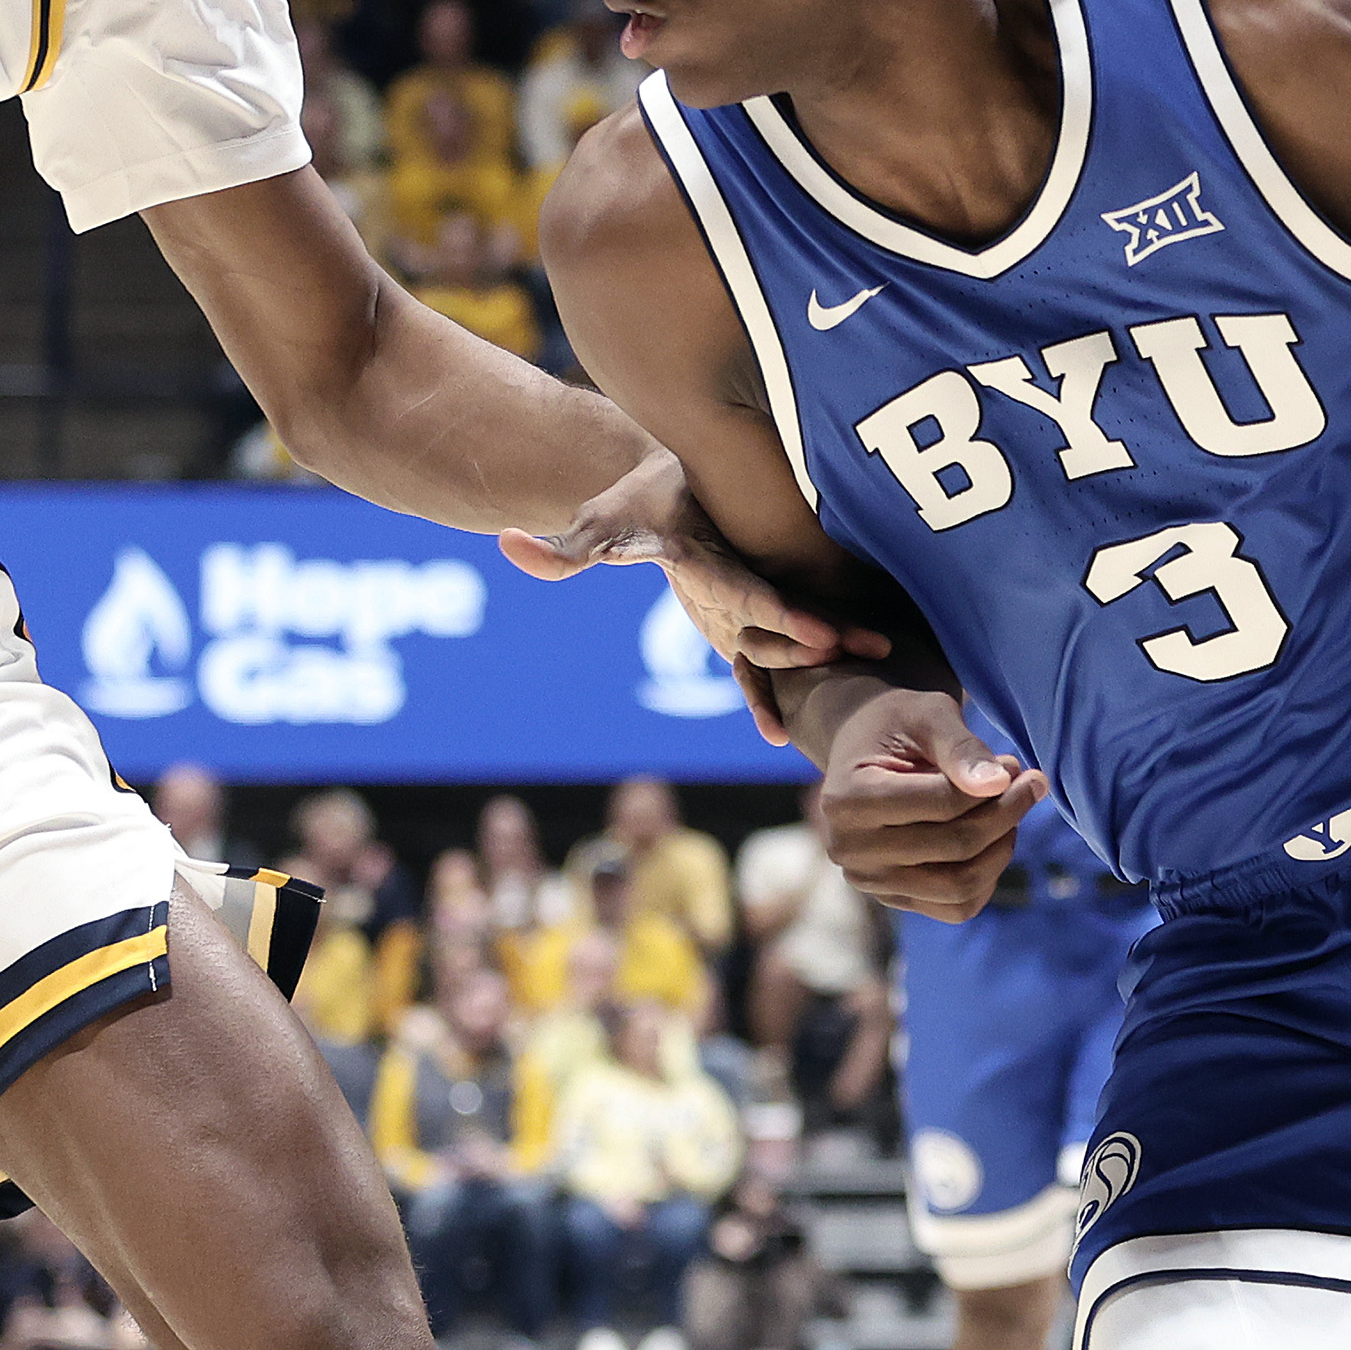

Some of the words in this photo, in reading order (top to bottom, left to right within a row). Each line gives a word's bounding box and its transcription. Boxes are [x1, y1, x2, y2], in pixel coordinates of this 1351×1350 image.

[854, 312, 1326, 531] BYU
[198, 543, 488, 640] Hope
[1082, 521, 1290, 682] 3
[198, 638, 407, 724] Gas
